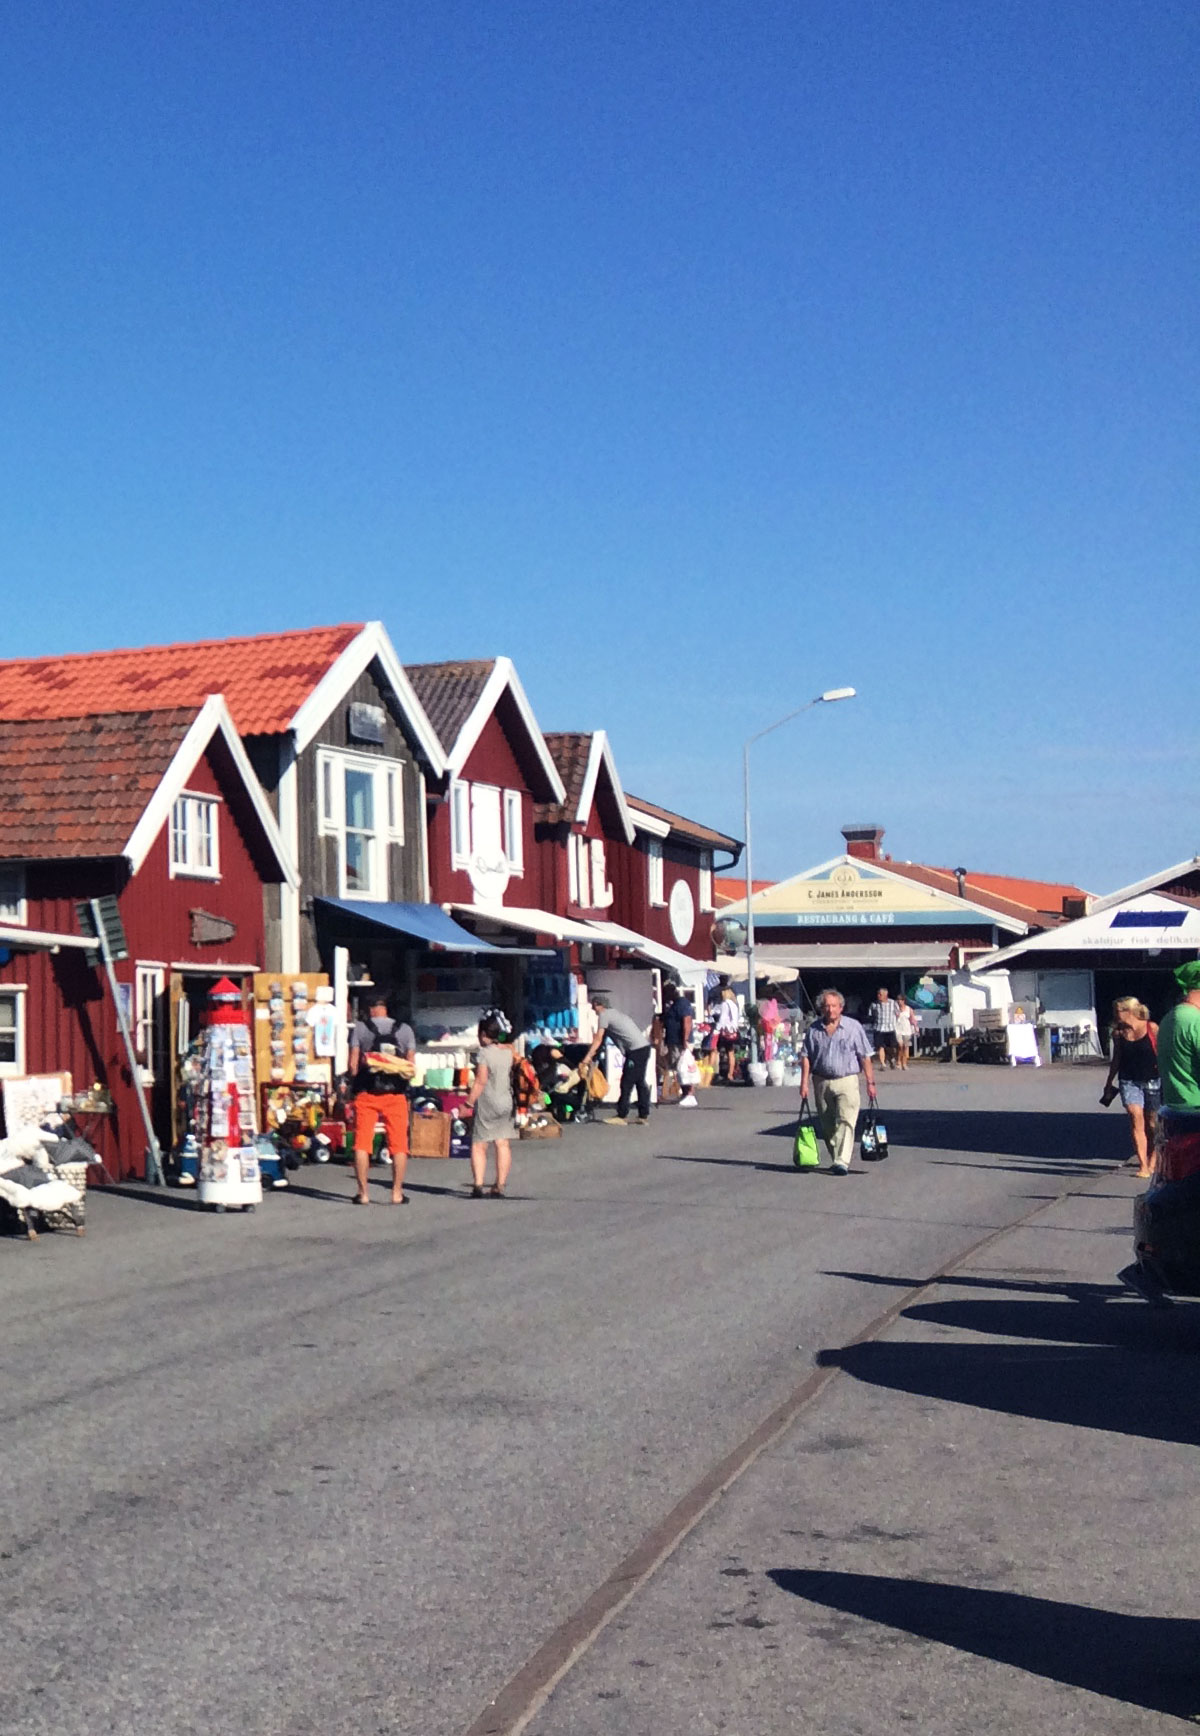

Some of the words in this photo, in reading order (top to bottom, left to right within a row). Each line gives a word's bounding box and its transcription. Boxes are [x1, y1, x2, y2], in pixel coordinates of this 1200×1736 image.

[817, 890, 839, 899] JAMES
[841, 889, 883, 898] ANDERSSON
[797, 914, 858, 925] RESTAURANG
[860, 914, 868, 924] &
[870, 912, 895, 924] CAFÉ
[1131, 936, 1150, 944] fisk
